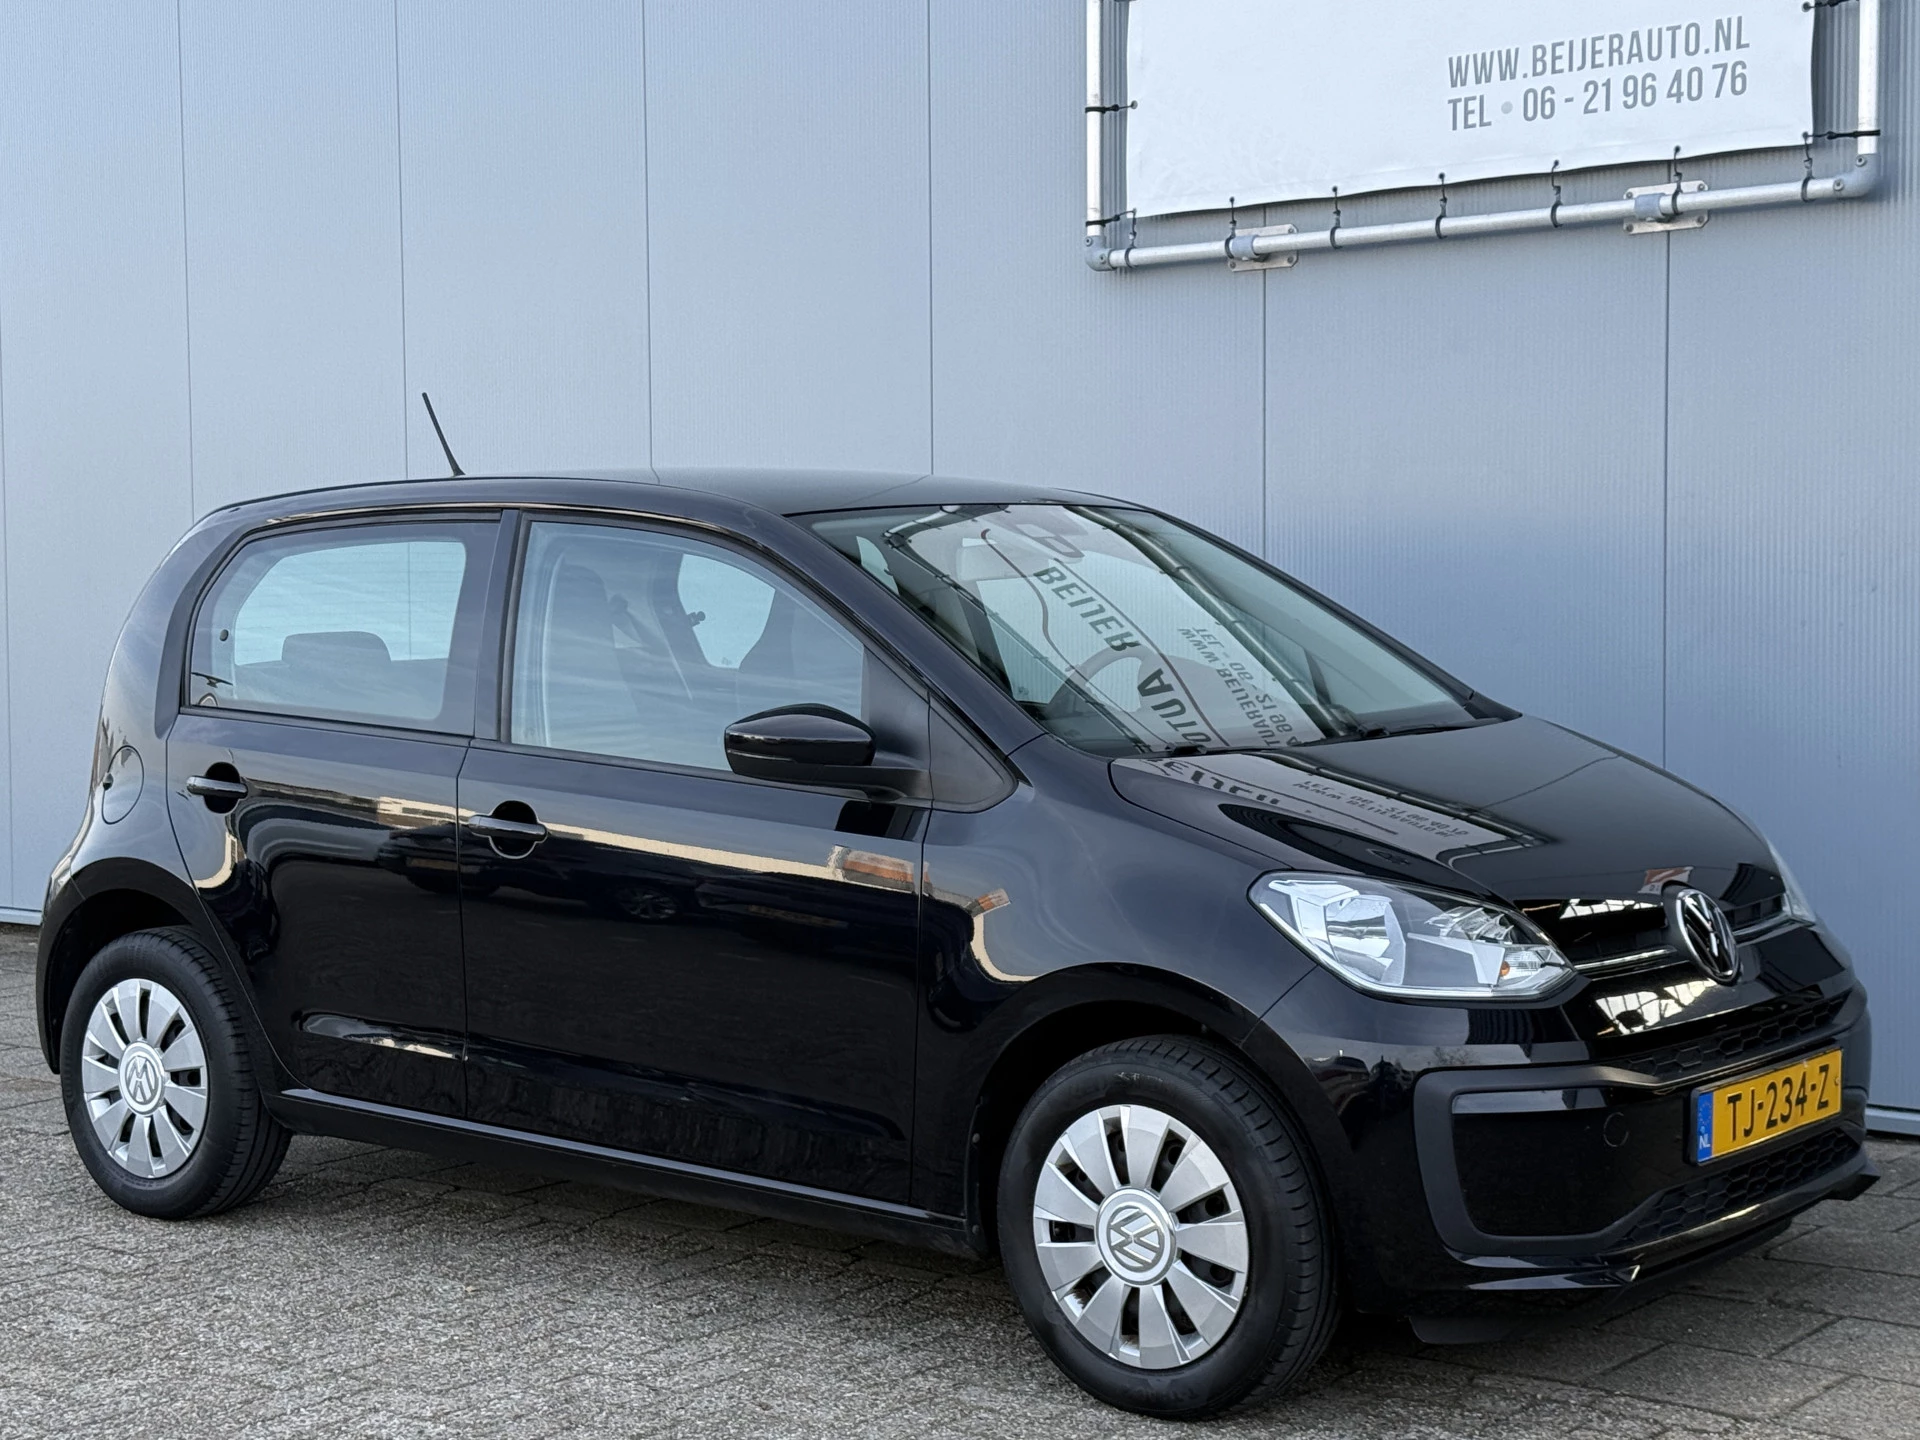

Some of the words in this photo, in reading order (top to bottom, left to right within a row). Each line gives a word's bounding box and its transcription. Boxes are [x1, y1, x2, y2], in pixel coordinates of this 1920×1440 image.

[1448, 15, 1750, 88] WWW.BEIJERAUTO.NL
[1448, 94, 1492, 131] TEL
[1522, 86, 1556, 121] 06
[1583, 78, 1611, 115] 21
[1622, 72, 1657, 110] 96
[1666, 66, 1703, 104] 40
[1711, 60, 1748, 99] 76
[1727, 1064, 1830, 1142] TJ-234-Z
[1699, 1133, 1711, 1150] NL
